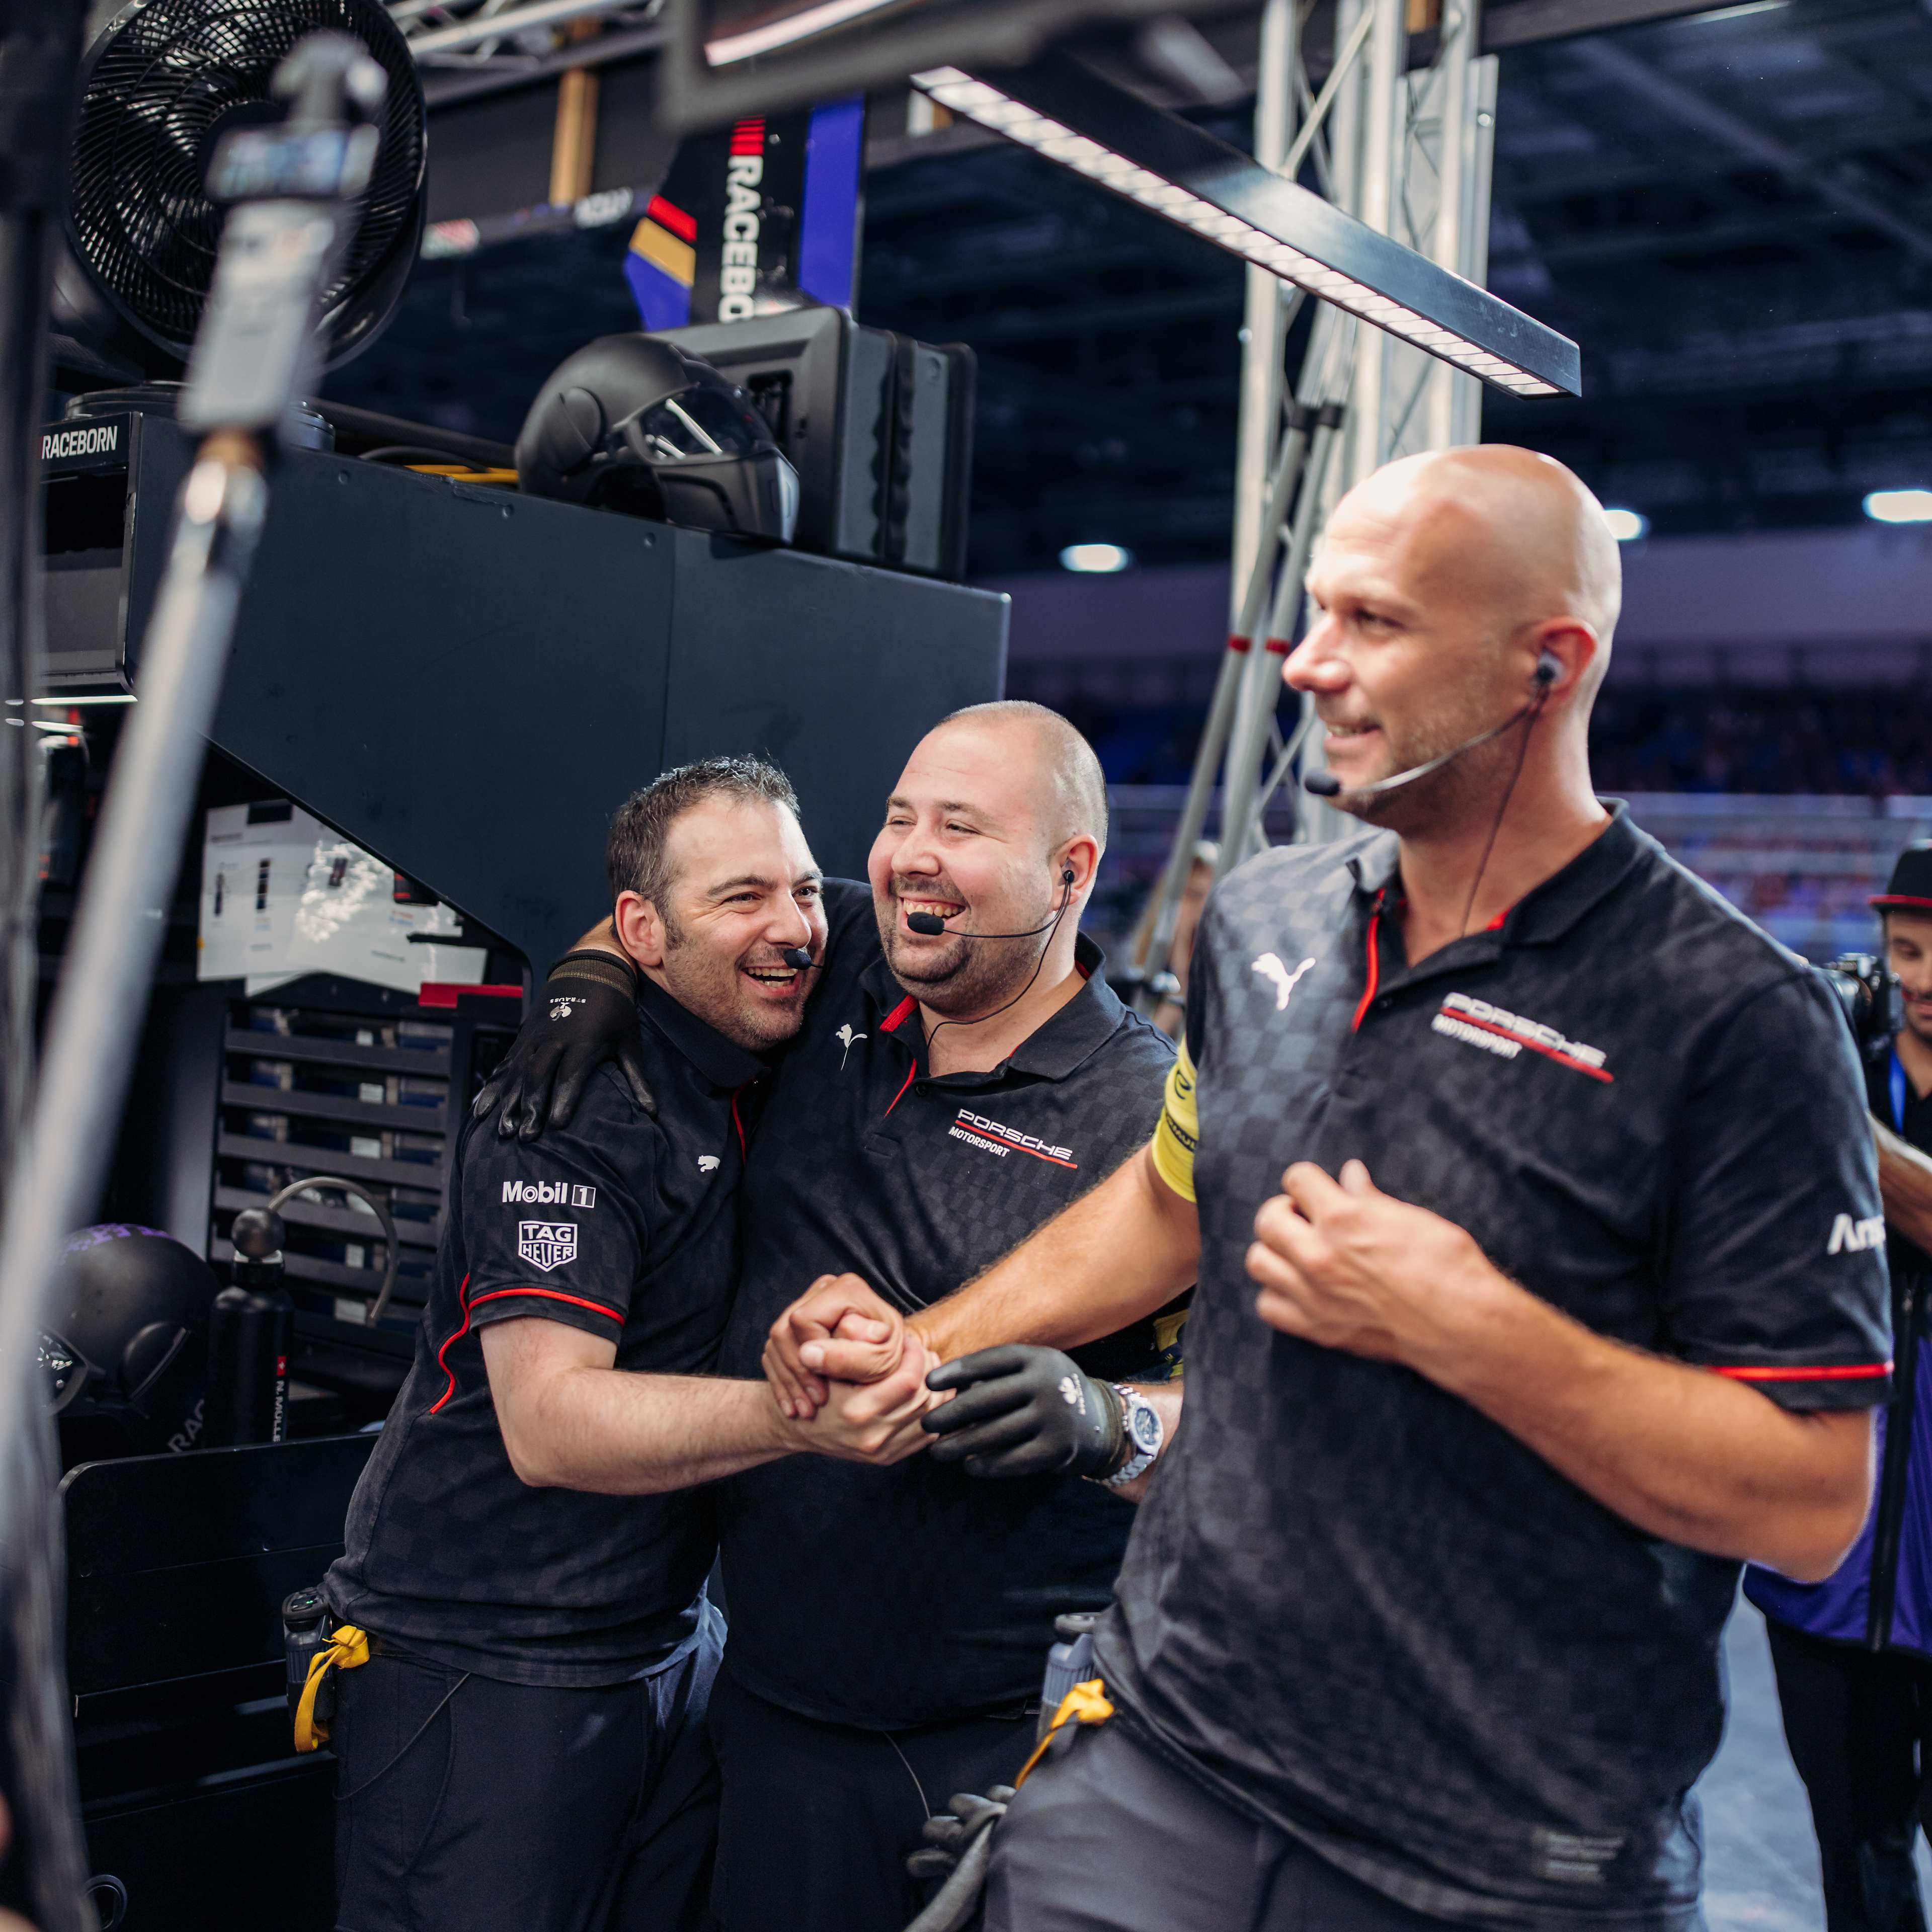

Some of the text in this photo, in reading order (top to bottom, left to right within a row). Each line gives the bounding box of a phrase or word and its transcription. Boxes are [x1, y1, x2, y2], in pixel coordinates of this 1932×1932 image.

[41, 426, 118, 459] RACEBORN
[948, 1126, 1010, 1158] MOTORSPORT
[957, 1108, 1073, 1160] PORSCHE
[502, 1181, 568, 1204] Mobil
[523, 1225, 572, 1242] TAG
[522, 1243, 573, 1267] HEUER
